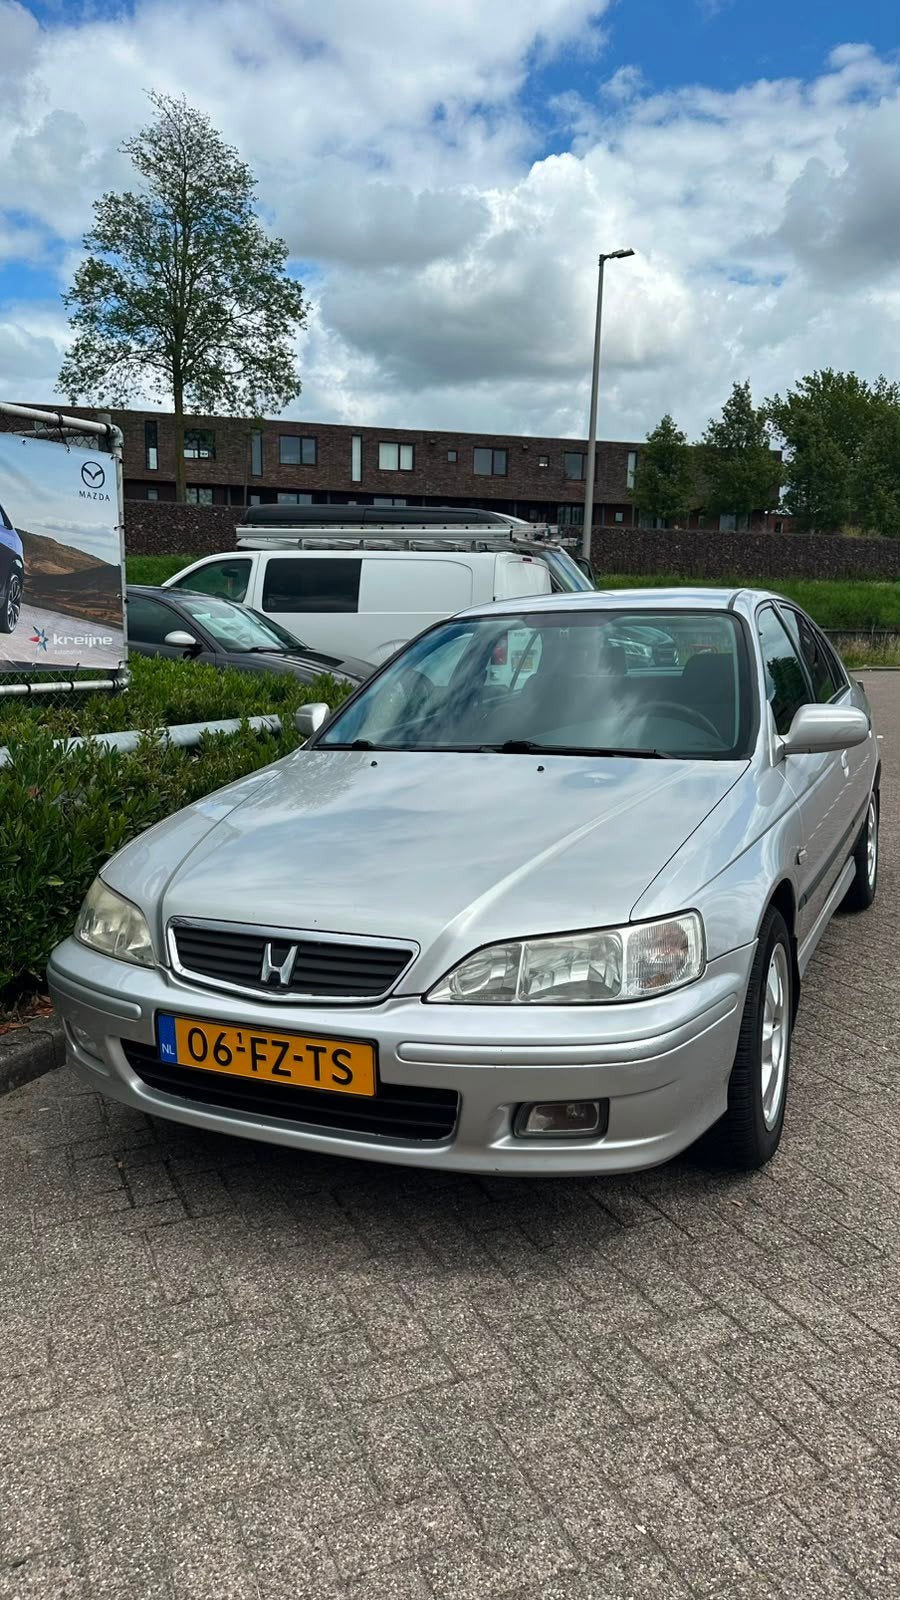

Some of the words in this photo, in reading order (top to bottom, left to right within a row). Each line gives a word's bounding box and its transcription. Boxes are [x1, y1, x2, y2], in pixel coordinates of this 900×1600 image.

[79, 490, 110, 501] MAZDA
[53, 633, 113, 648] kreijne
[162, 1043, 175, 1055] NL
